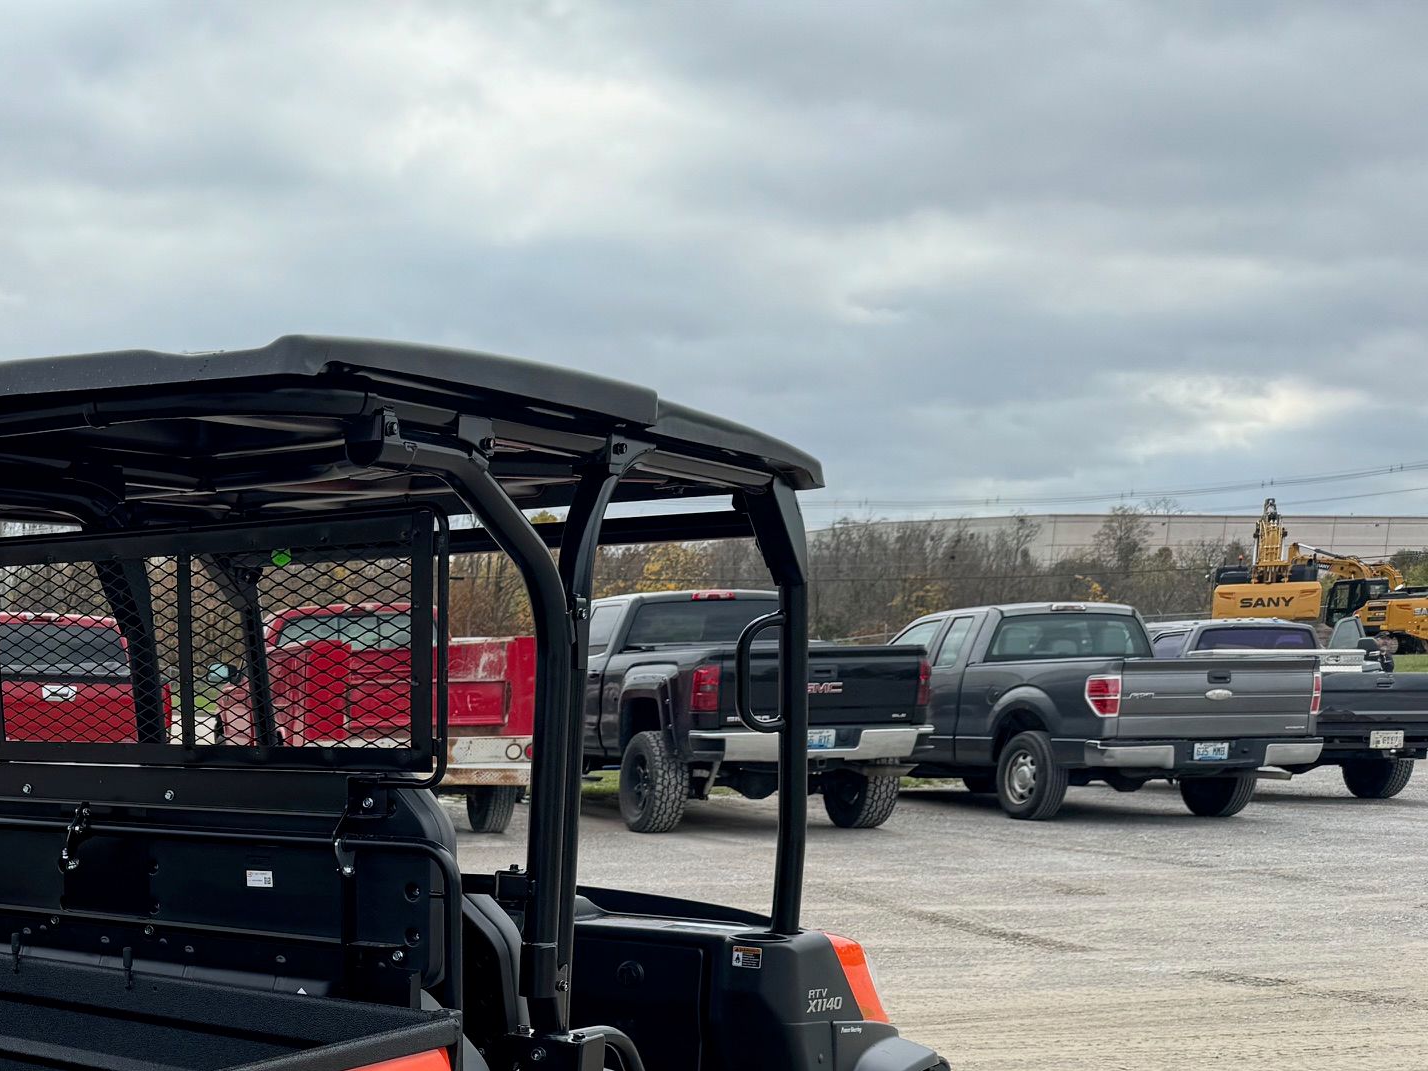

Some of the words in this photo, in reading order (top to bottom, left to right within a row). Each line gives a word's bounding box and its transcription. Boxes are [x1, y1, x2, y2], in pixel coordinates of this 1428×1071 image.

[1239, 597, 1295, 608] SANY
[808, 988, 828, 999] RTV
[806, 997, 843, 1013] X1140
